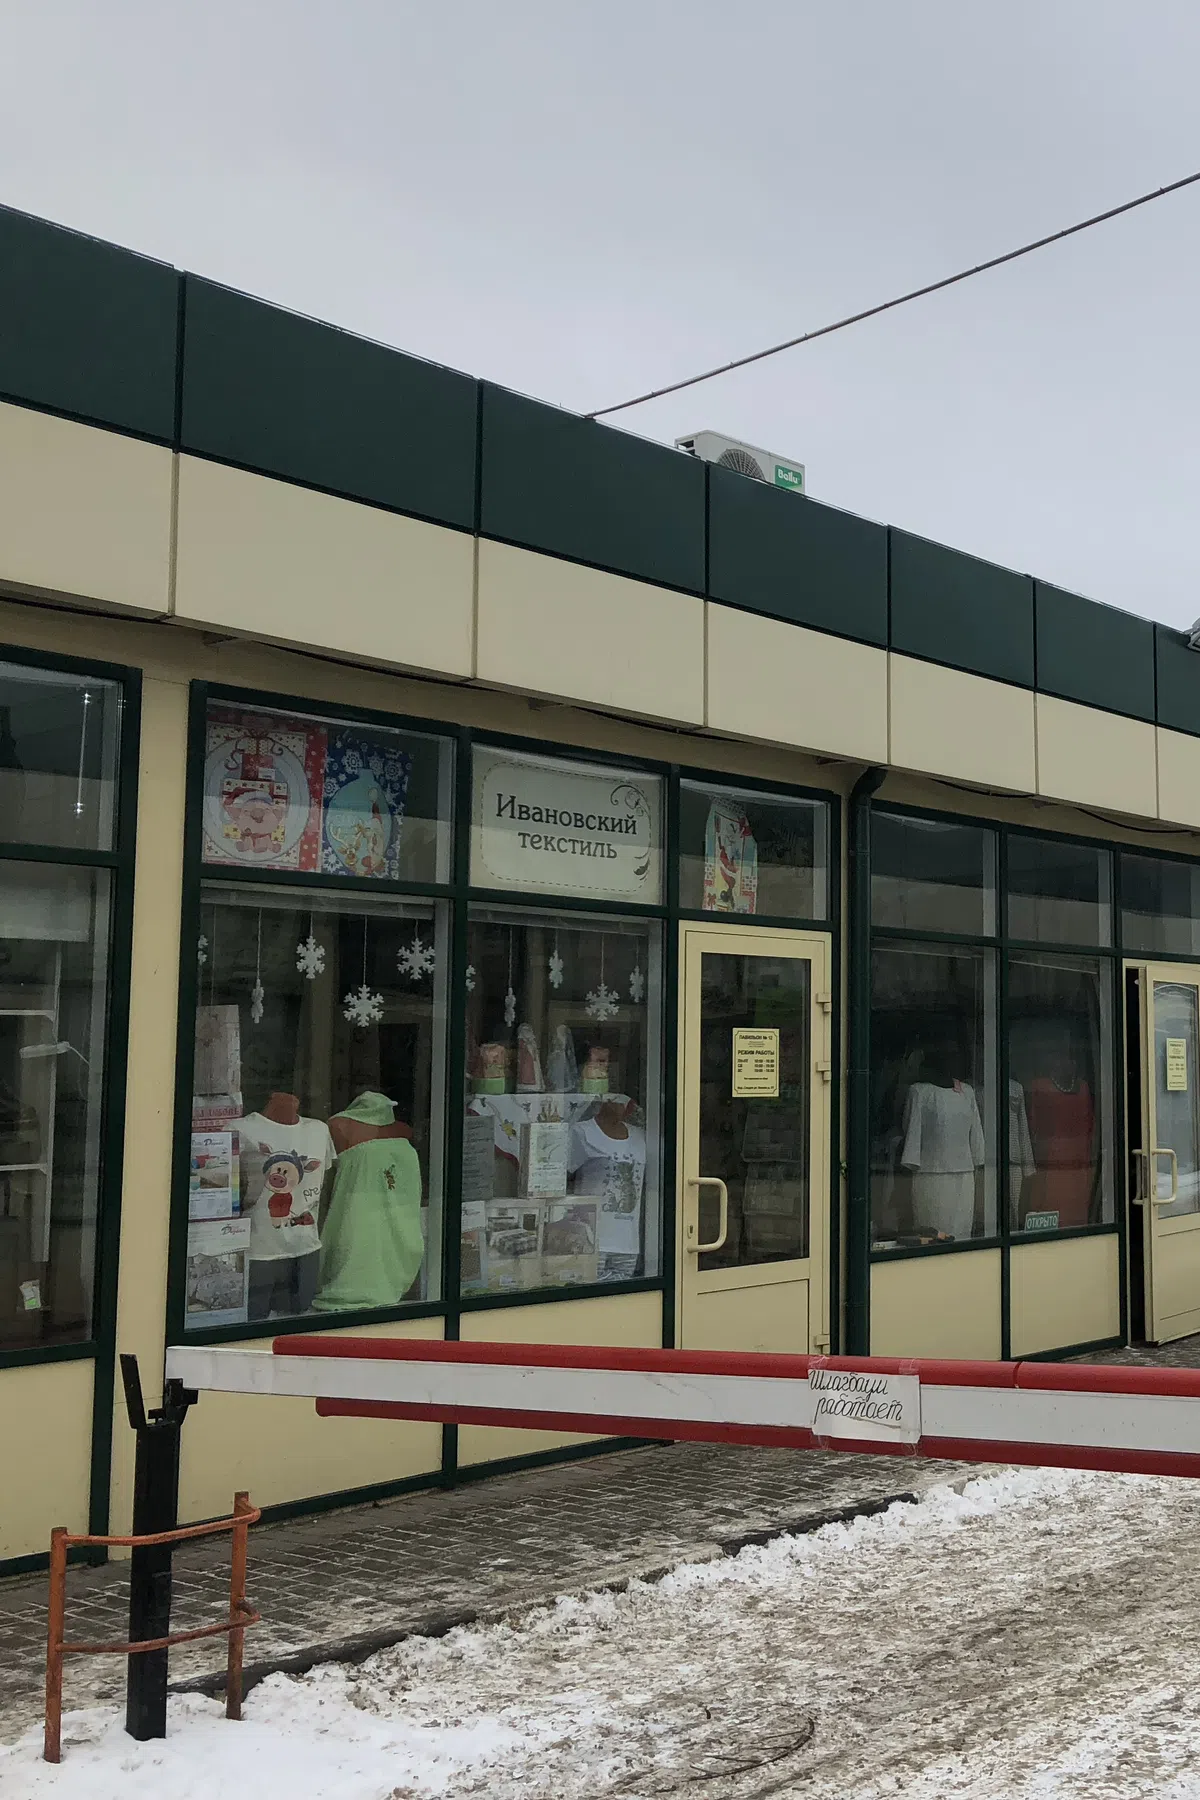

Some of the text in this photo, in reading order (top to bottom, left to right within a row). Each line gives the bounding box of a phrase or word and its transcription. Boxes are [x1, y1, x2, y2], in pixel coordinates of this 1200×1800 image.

[778, 468, 798, 484] Ballu
[496, 793, 637, 835] Ивановский
[518, 832, 618, 859] текстиль
[1026, 1215, 1058, 1229] ОТКРЫТО
[809, 1370, 888, 1402] Шлагбаум
[813, 1393, 903, 1425] работает
